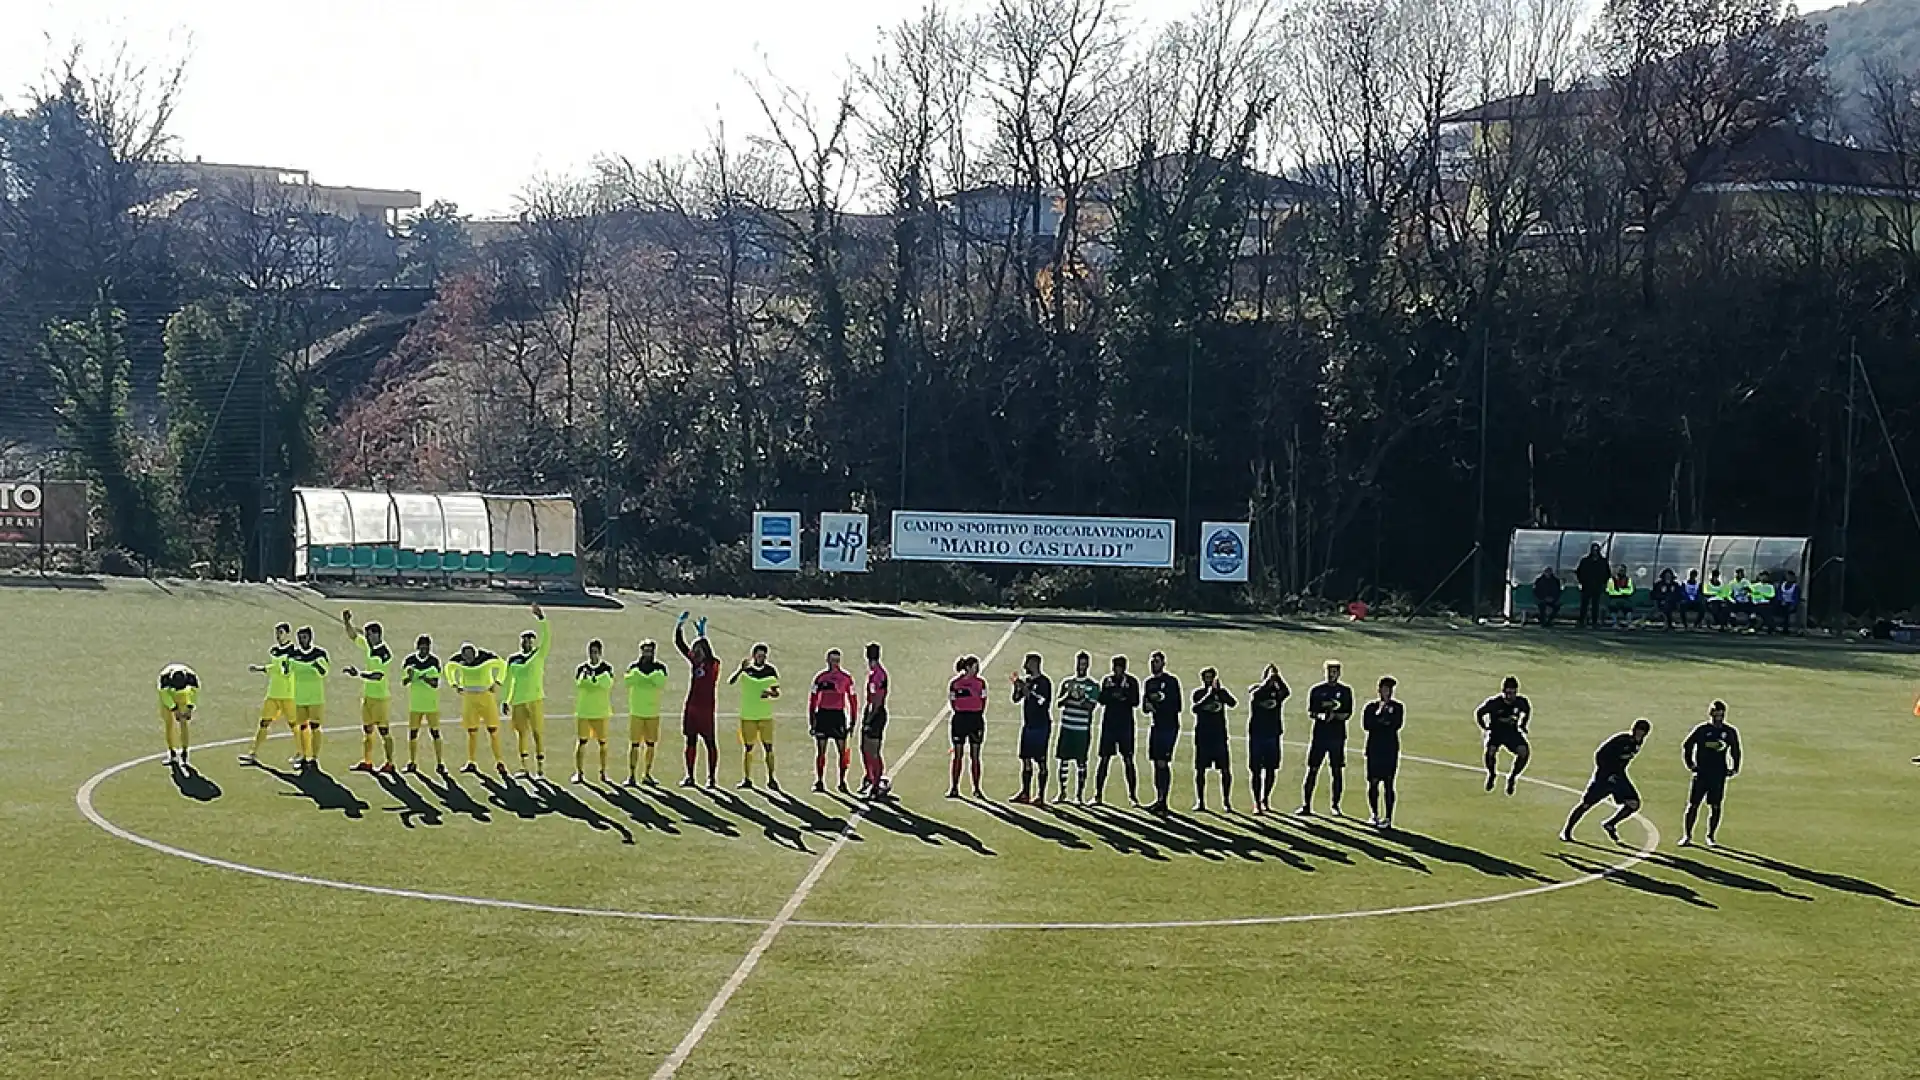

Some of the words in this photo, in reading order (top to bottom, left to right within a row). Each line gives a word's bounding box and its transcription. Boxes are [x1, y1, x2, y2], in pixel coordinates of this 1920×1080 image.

[903, 521, 953, 532] CAMPO
[958, 522, 1028, 535] SPORTIVO
[1033, 524, 1164, 539] ROCCARAVINDOLA
[930, 537, 1010, 554] "MARIO
[1018, 540, 1134, 558] CASTALDI"
